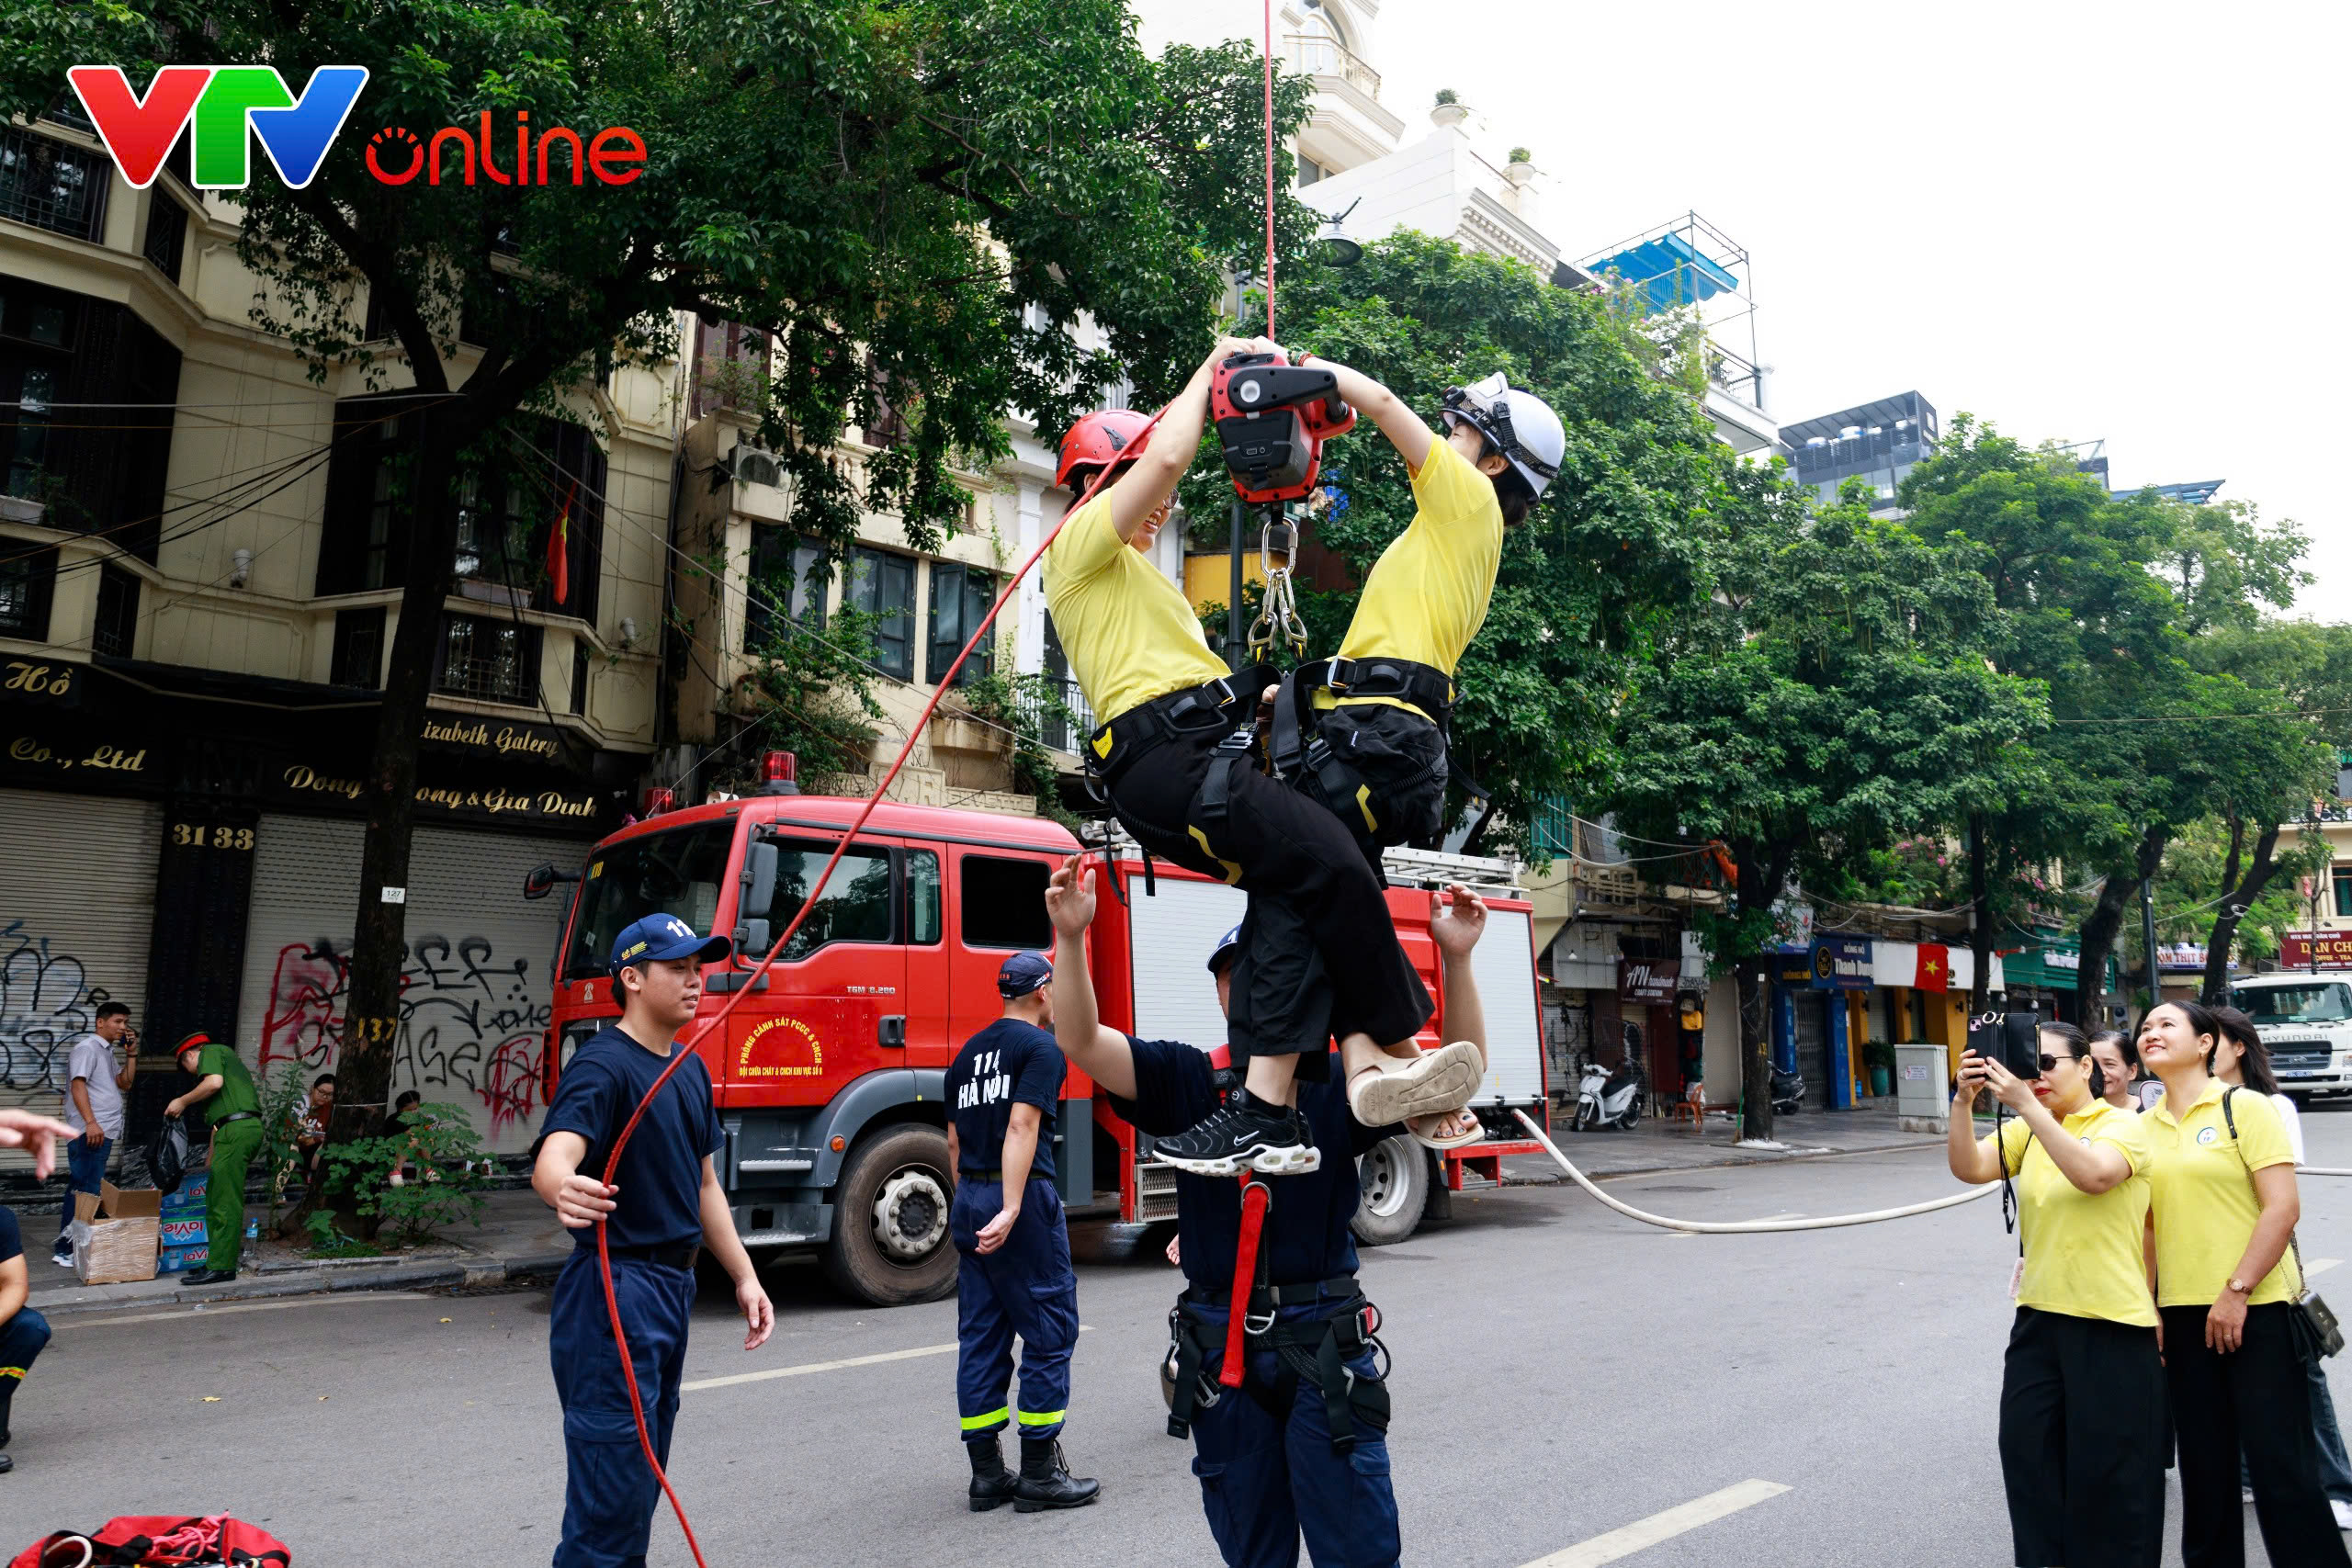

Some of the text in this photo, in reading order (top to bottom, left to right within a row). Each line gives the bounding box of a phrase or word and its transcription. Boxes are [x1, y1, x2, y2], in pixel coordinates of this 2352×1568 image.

[6, 661, 74, 695] Hồ
[494, 727, 559, 758] Galery
[81, 745, 147, 771] Ltd
[467, 791, 479, 806] &
[481, 787, 530, 813] Gia
[172, 824, 254, 850] 31 33
[666, 919, 696, 938] 11
[1627, 965, 1650, 988] AN
[846, 986, 865, 994] TGM
[357, 1017, 397, 1042] 137
[775, 1016, 789, 1027] SÁT
[790, 1019, 810, 1035] PCCC
[811, 1041, 822, 1064] CNCH
[2263, 1033, 2328, 1042] HYUNDAI
[958, 1070, 1011, 1109] HÀ NỘI
